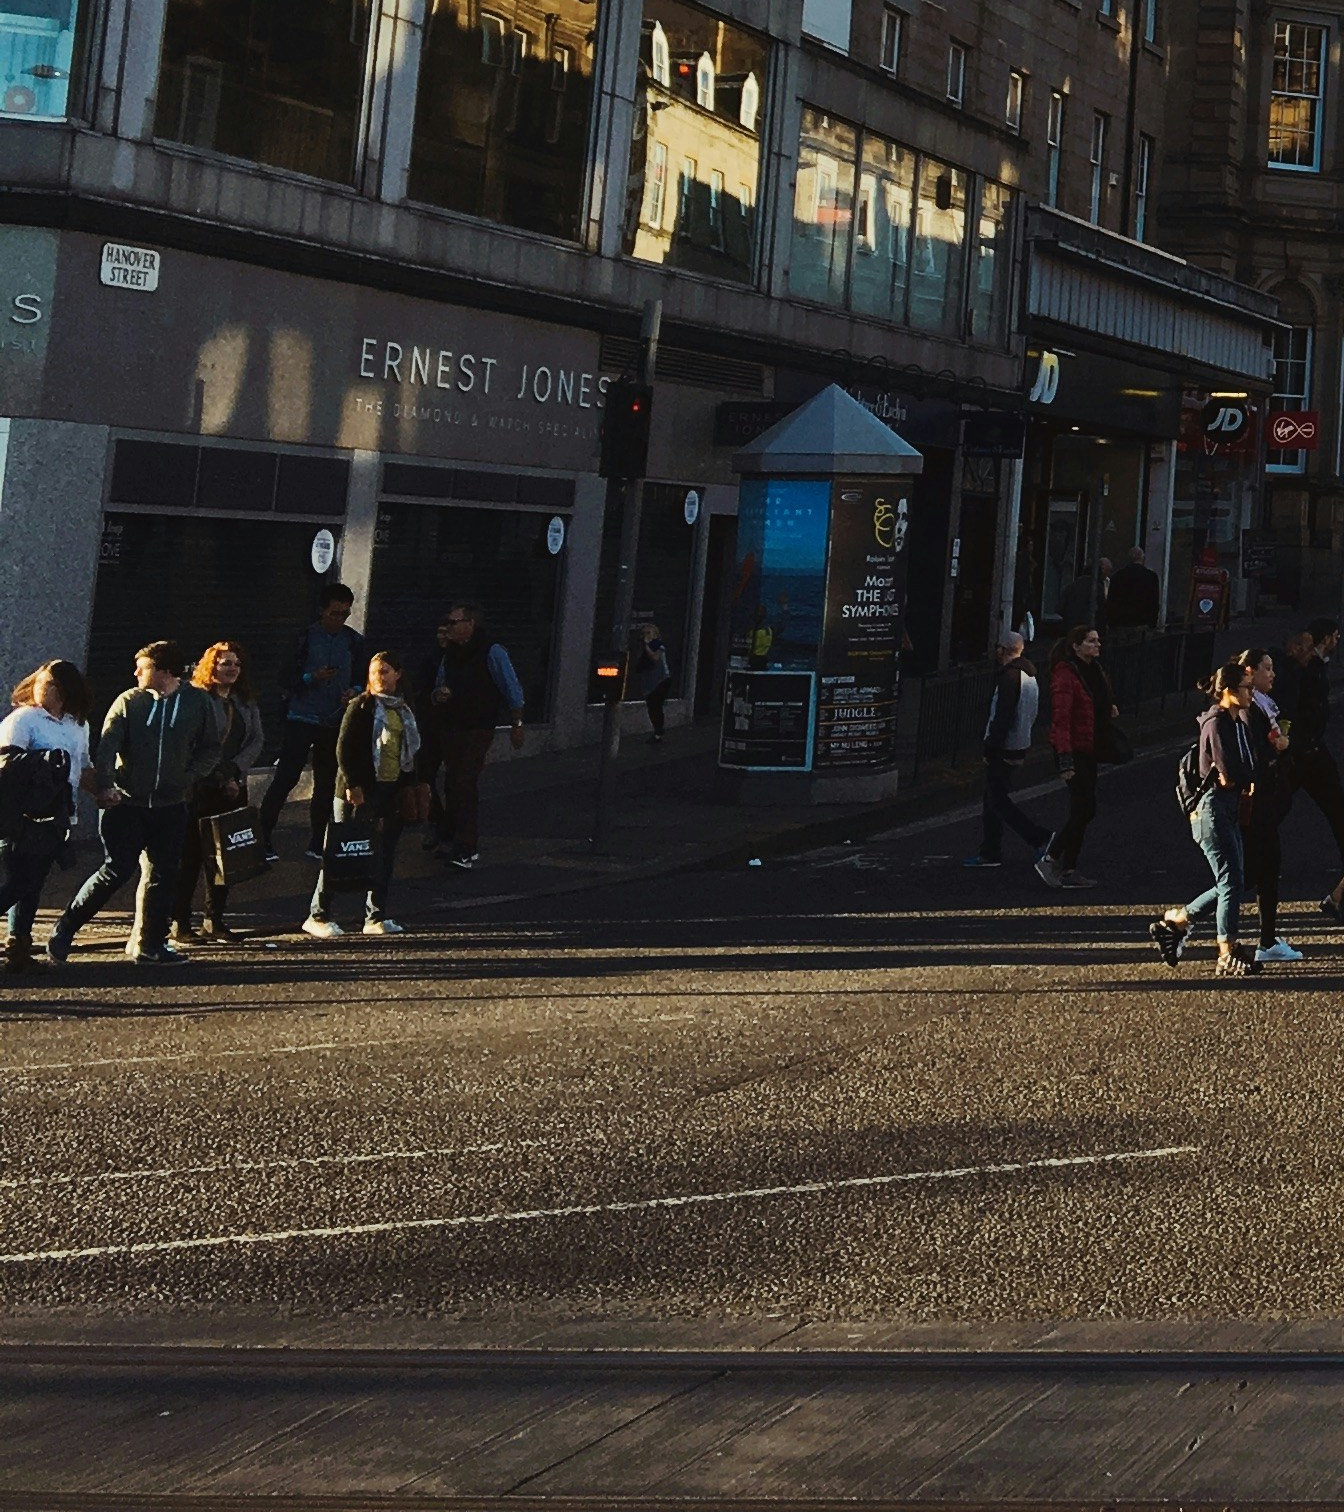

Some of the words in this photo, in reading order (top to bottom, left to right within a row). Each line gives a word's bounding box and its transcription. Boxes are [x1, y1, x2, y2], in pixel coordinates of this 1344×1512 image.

[105, 246, 156, 271] HANOVER
[109, 266, 150, 287] STREET
[360, 338, 498, 394] ERNEST
[517, 365, 612, 408] JONES
[354, 398, 383, 416] THE
[1206, 407, 1244, 432] JD
[856, 589, 881, 602] THE
[832, 706, 876, 721] JUNGLE
[228, 828, 254, 844] VANS
[340, 840, 370, 852] VANS
